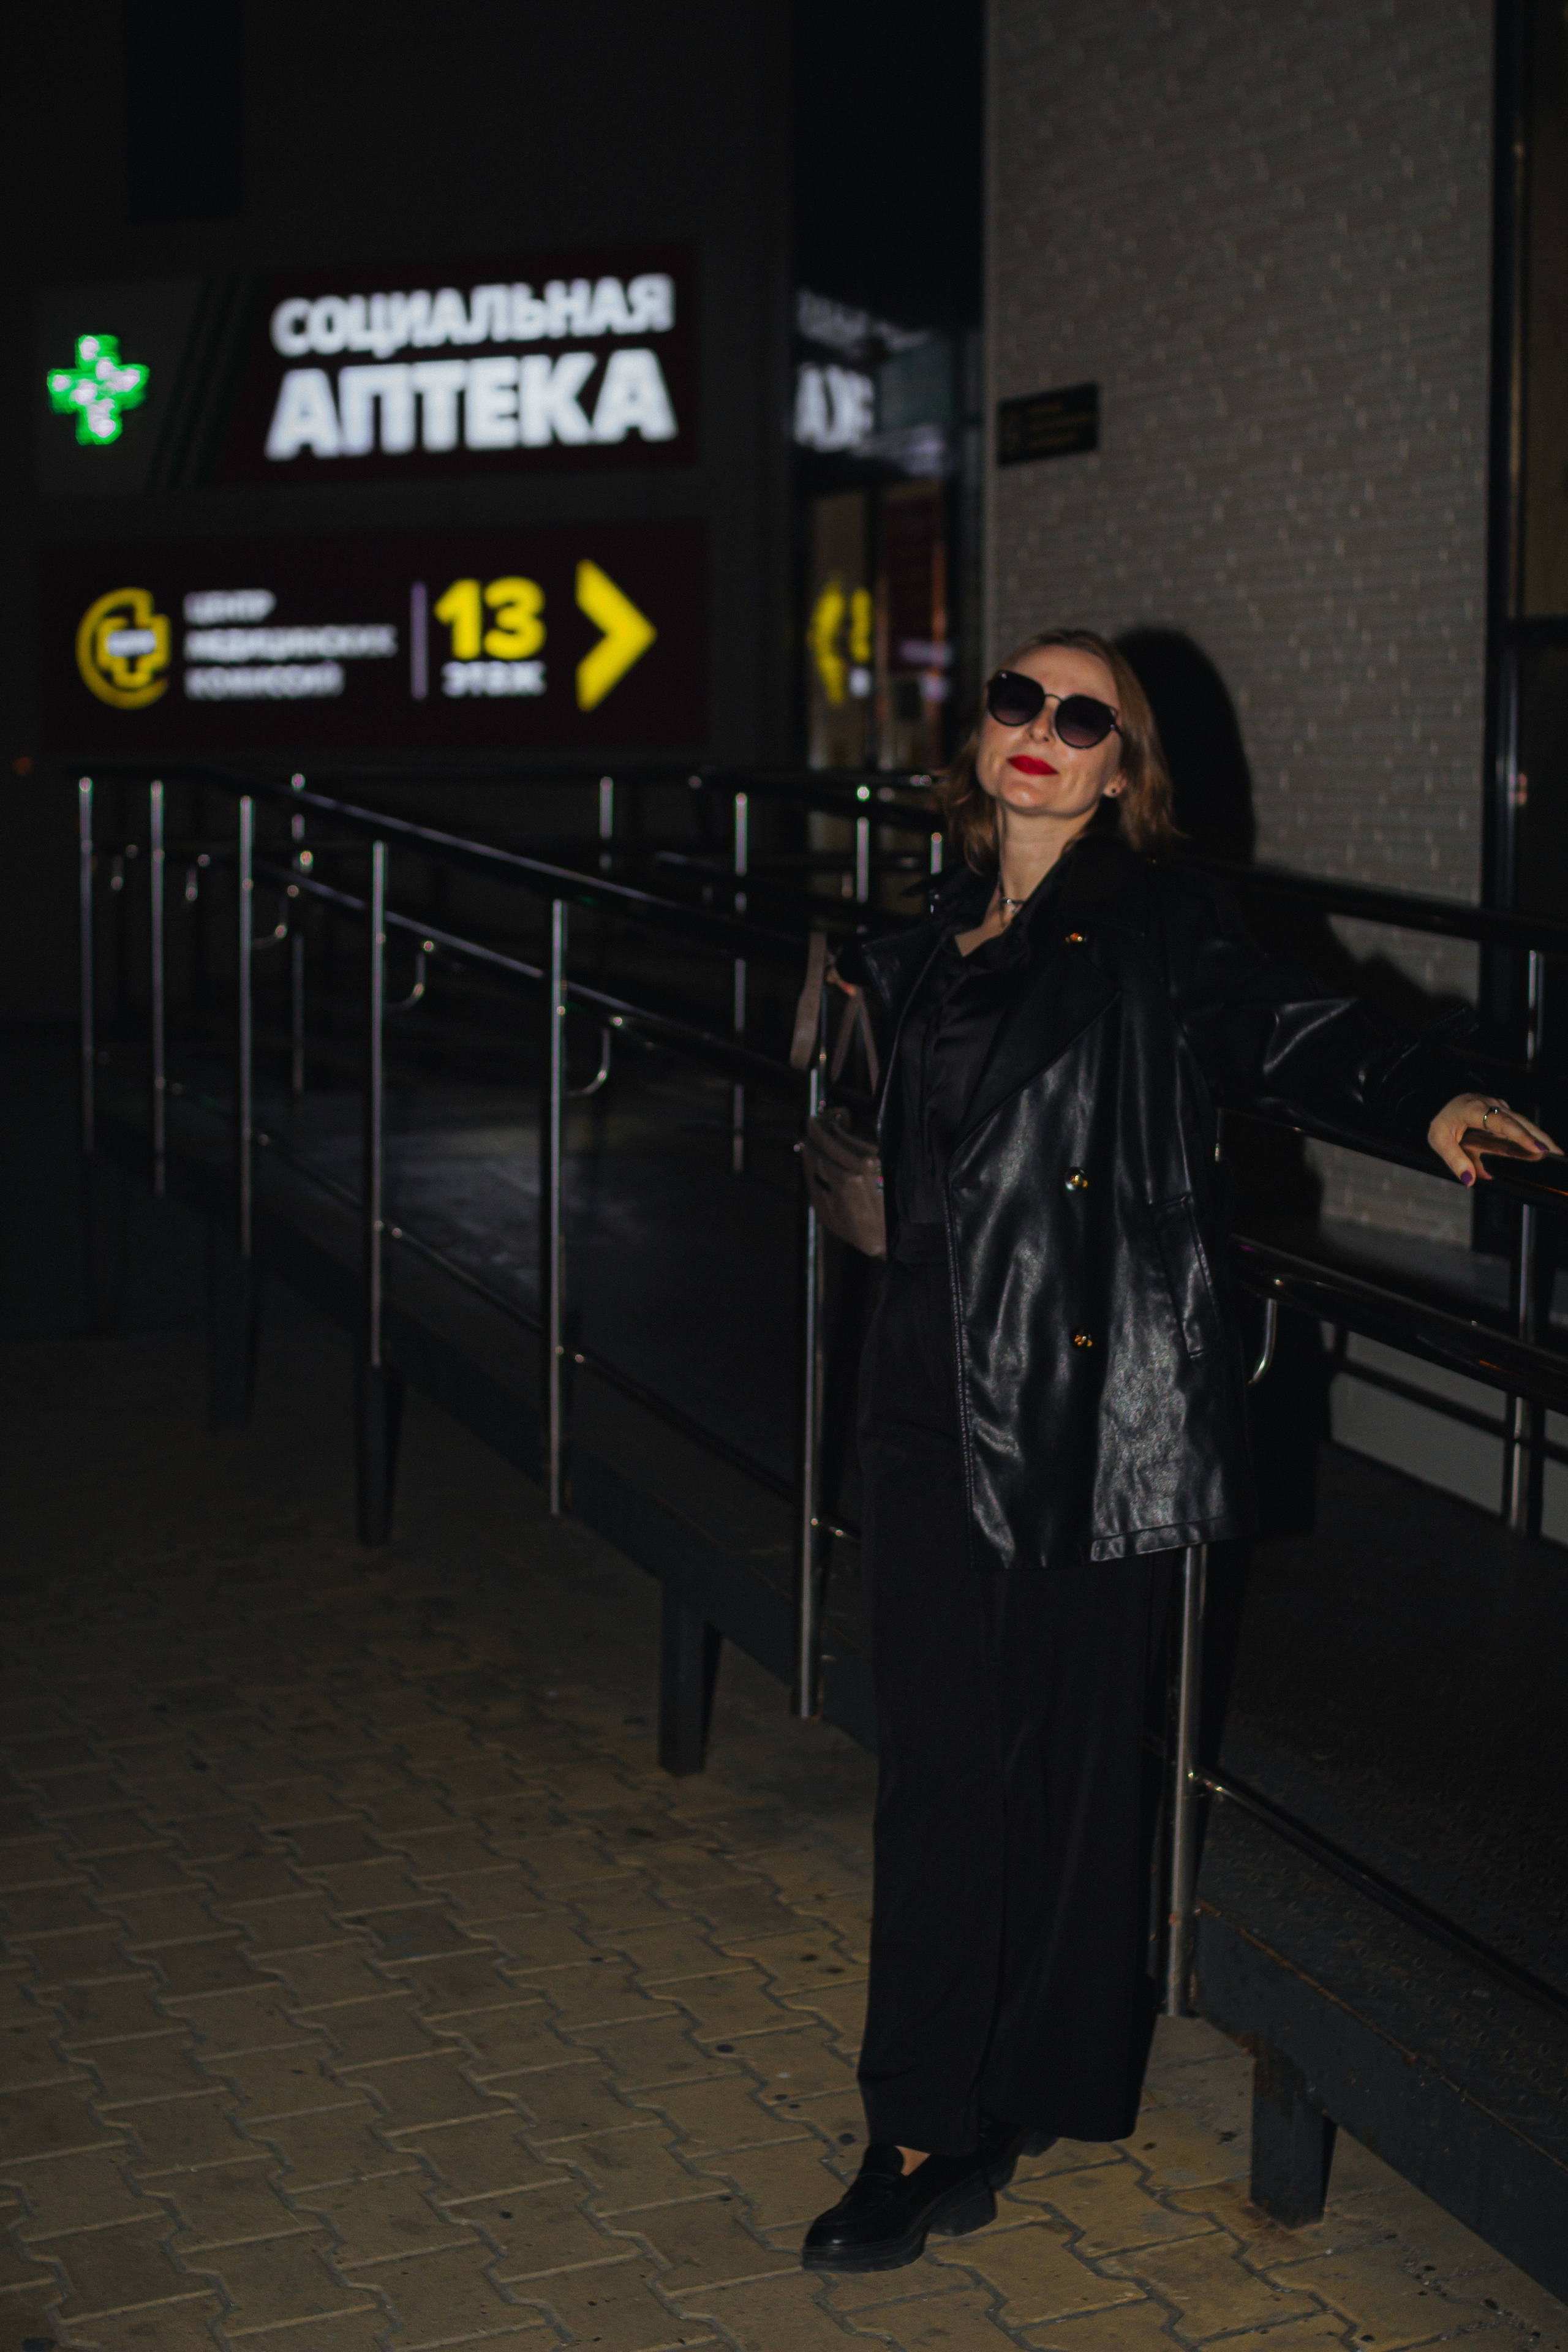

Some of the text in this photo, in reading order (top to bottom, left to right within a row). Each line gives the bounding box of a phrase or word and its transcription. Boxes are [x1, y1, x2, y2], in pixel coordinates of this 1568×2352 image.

[271, 274, 674, 359] СОЦИАЛЬНАЯ
[265, 349, 677, 460] АПТЕКА
[435, 576, 545, 659] 13
[442, 660, 546, 696] ЭТАЖ
